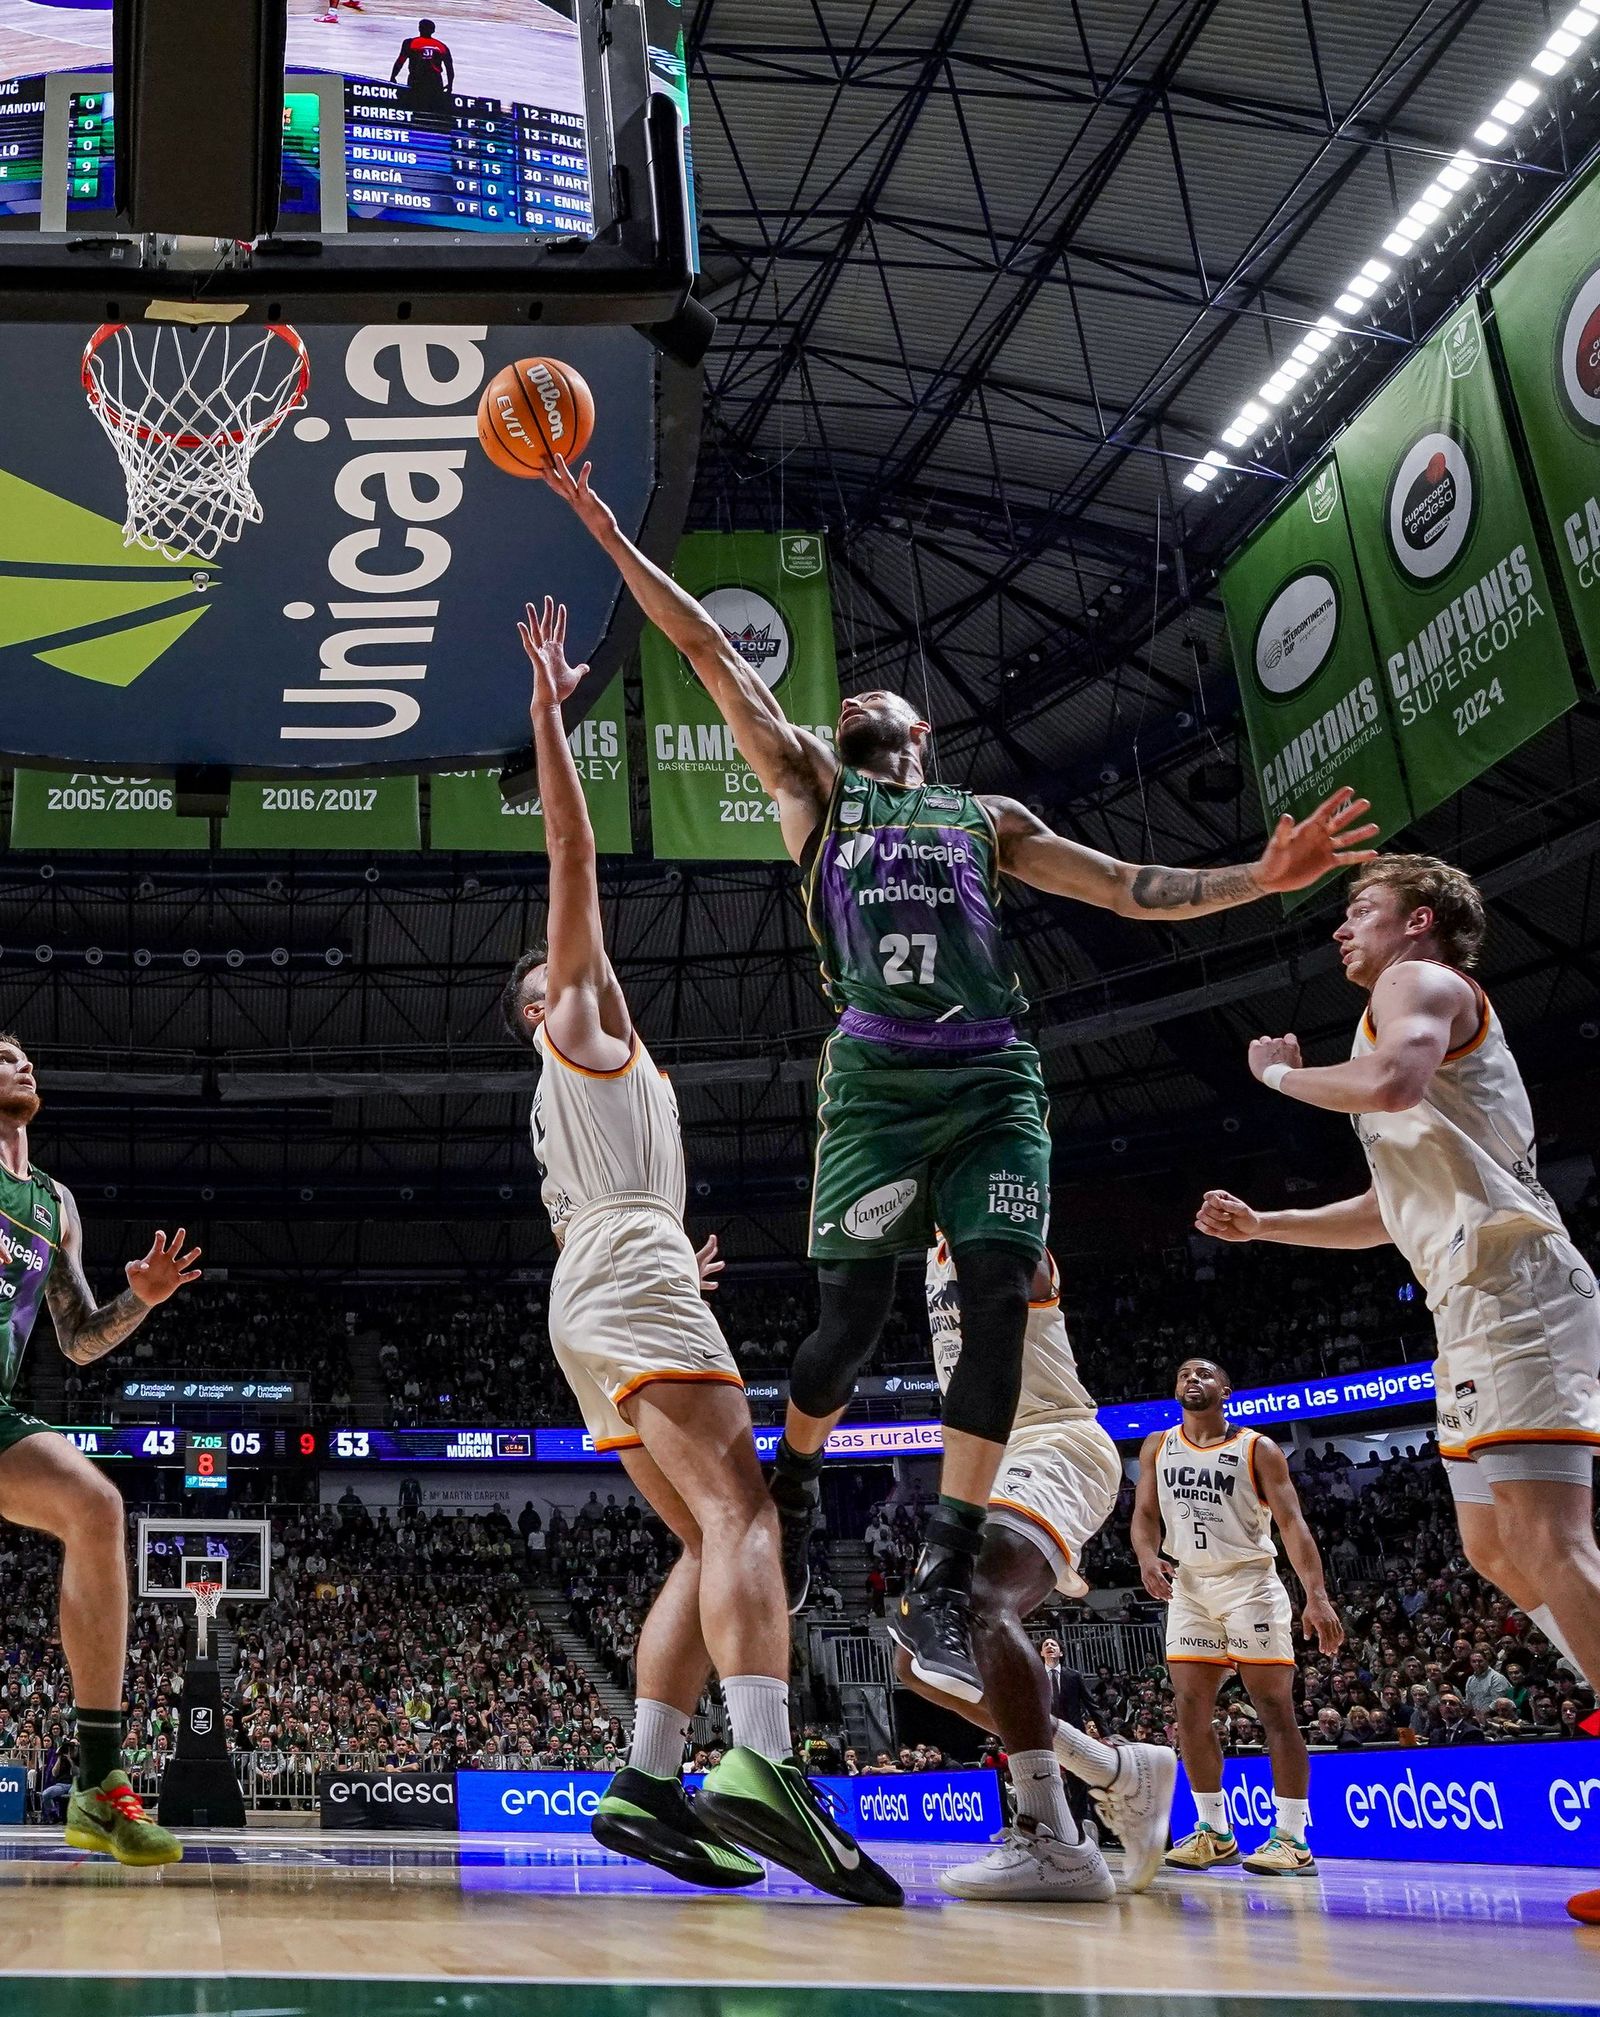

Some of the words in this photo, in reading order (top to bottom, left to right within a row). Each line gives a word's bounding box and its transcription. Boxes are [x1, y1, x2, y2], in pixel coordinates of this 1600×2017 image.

[353, 84, 398, 100] CACOK
[85, 97, 95, 110] 0
[455, 97, 463, 107] 0
[467, 98, 475, 108] F
[486, 102, 493, 112] 1
[353, 105, 413, 122] FORREST
[523, 107, 539, 120] 12
[550, 114, 586, 130] RADE
[84, 120, 94, 130] 0
[456, 118, 462, 128] 1
[468, 119, 476, 129] F
[485, 121, 496, 133] 0
[353, 126, 410, 143] RAIESTE
[523, 127, 540, 141] 13
[551, 133, 583, 150] FALK
[0, 144, 19, 157] LO
[83, 140, 93, 151] 0
[456, 139, 462, 149] 1
[468, 140, 476, 149] F
[486, 143, 496, 154] 6
[353, 147, 417, 164] DEJULIUS
[524, 148, 541, 162] 15
[82, 162, 92, 172] 9
[353, 168, 403, 184] GARCÍA
[456, 160, 463, 170] 1
[468, 161, 477, 170] F
[483, 163, 501, 175] 15
[80, 182, 91, 194] 4
[456, 180, 465, 191] 0
[469, 181, 477, 191] F
[487, 184, 497, 195] 0
[524, 169, 542, 182] 30
[553, 174, 590, 191] MART
[353, 189, 432, 208] SANT-ROOS
[524, 190, 541, 203] 31
[554, 195, 592, 213] ENNIS
[456, 202, 465, 212] 0
[469, 203, 478, 213] F
[488, 205, 498, 217] 6
[525, 211, 544, 225] 99
[526, 363, 564, 442] Wilson
[1404, 478, 1450, 526] supercopa
[1410, 489, 1454, 534] endesa
[280, 324, 489, 740] Unicaja
[1282, 597, 1334, 647] INTERCONTINENTAL
[1387, 544, 1533, 699] CAMPEONES
[740, 641, 776, 651] FOUR
[1284, 641, 1295, 657] CUP
[1399, 593, 1545, 726] SUPERCOPA
[1452, 676, 1505, 737] 2024
[1262, 676, 1379, 806] CAMPEONES
[657, 762, 725, 772] BASKETBALL
[1292, 723, 1383, 800] INTERCONTINENTAL
[1317, 776, 1335, 797] CUP
[48, 788, 173, 811] 2005/2006
[262, 788, 378, 811] 2016/2017
[719, 800, 781, 822] 2024
[879, 839, 967, 867] Unicaja
[879, 933, 938, 986] 27
[989, 1169, 1027, 1183] sabor
[997, 1180, 1041, 1204] má
[987, 1193, 1038, 1223] laga
[0, 1228, 44, 1272] nicaja
[140, 1383, 175, 1392] Fundación
[140, 1390, 166, 1399] Unicaja
[199, 1384, 234, 1392] Fundación
[199, 1391, 224, 1399] Unicaja
[257, 1385, 292, 1393] Fundación
[257, 1391, 283, 1400] Unicaja
[744, 1386, 779, 1398] Unicaja
[903, 1381, 940, 1394] Unicaja
[1304, 1388, 1339, 1407] las
[1343, 1372, 1435, 1401] mejores
[142, 1430, 175, 1455] 43
[192, 1435, 222, 1448] 7:05
[230, 1432, 261, 1455] 05
[300, 1433, 315, 1455] 9
[337, 1432, 370, 1457] 53
[457, 1432, 493, 1446] UCAM
[870, 1428, 944, 1446] rurales
[446, 1444, 494, 1458] MURCIA
[198, 1452, 215, 1476] 8
[1163, 1466, 1236, 1497] UCAM
[1173, 1488, 1223, 1506] MURCIA
[1193, 1521, 1208, 1550] 5
[1180, 1637, 1226, 1650] INVERSUS
[329, 1776, 454, 1804] endesa
[1345, 1767, 1504, 1830] endesa
[502, 1782, 601, 1817] ende
[860, 1786, 909, 1821] endesa
[922, 1783, 983, 1822] endesa
